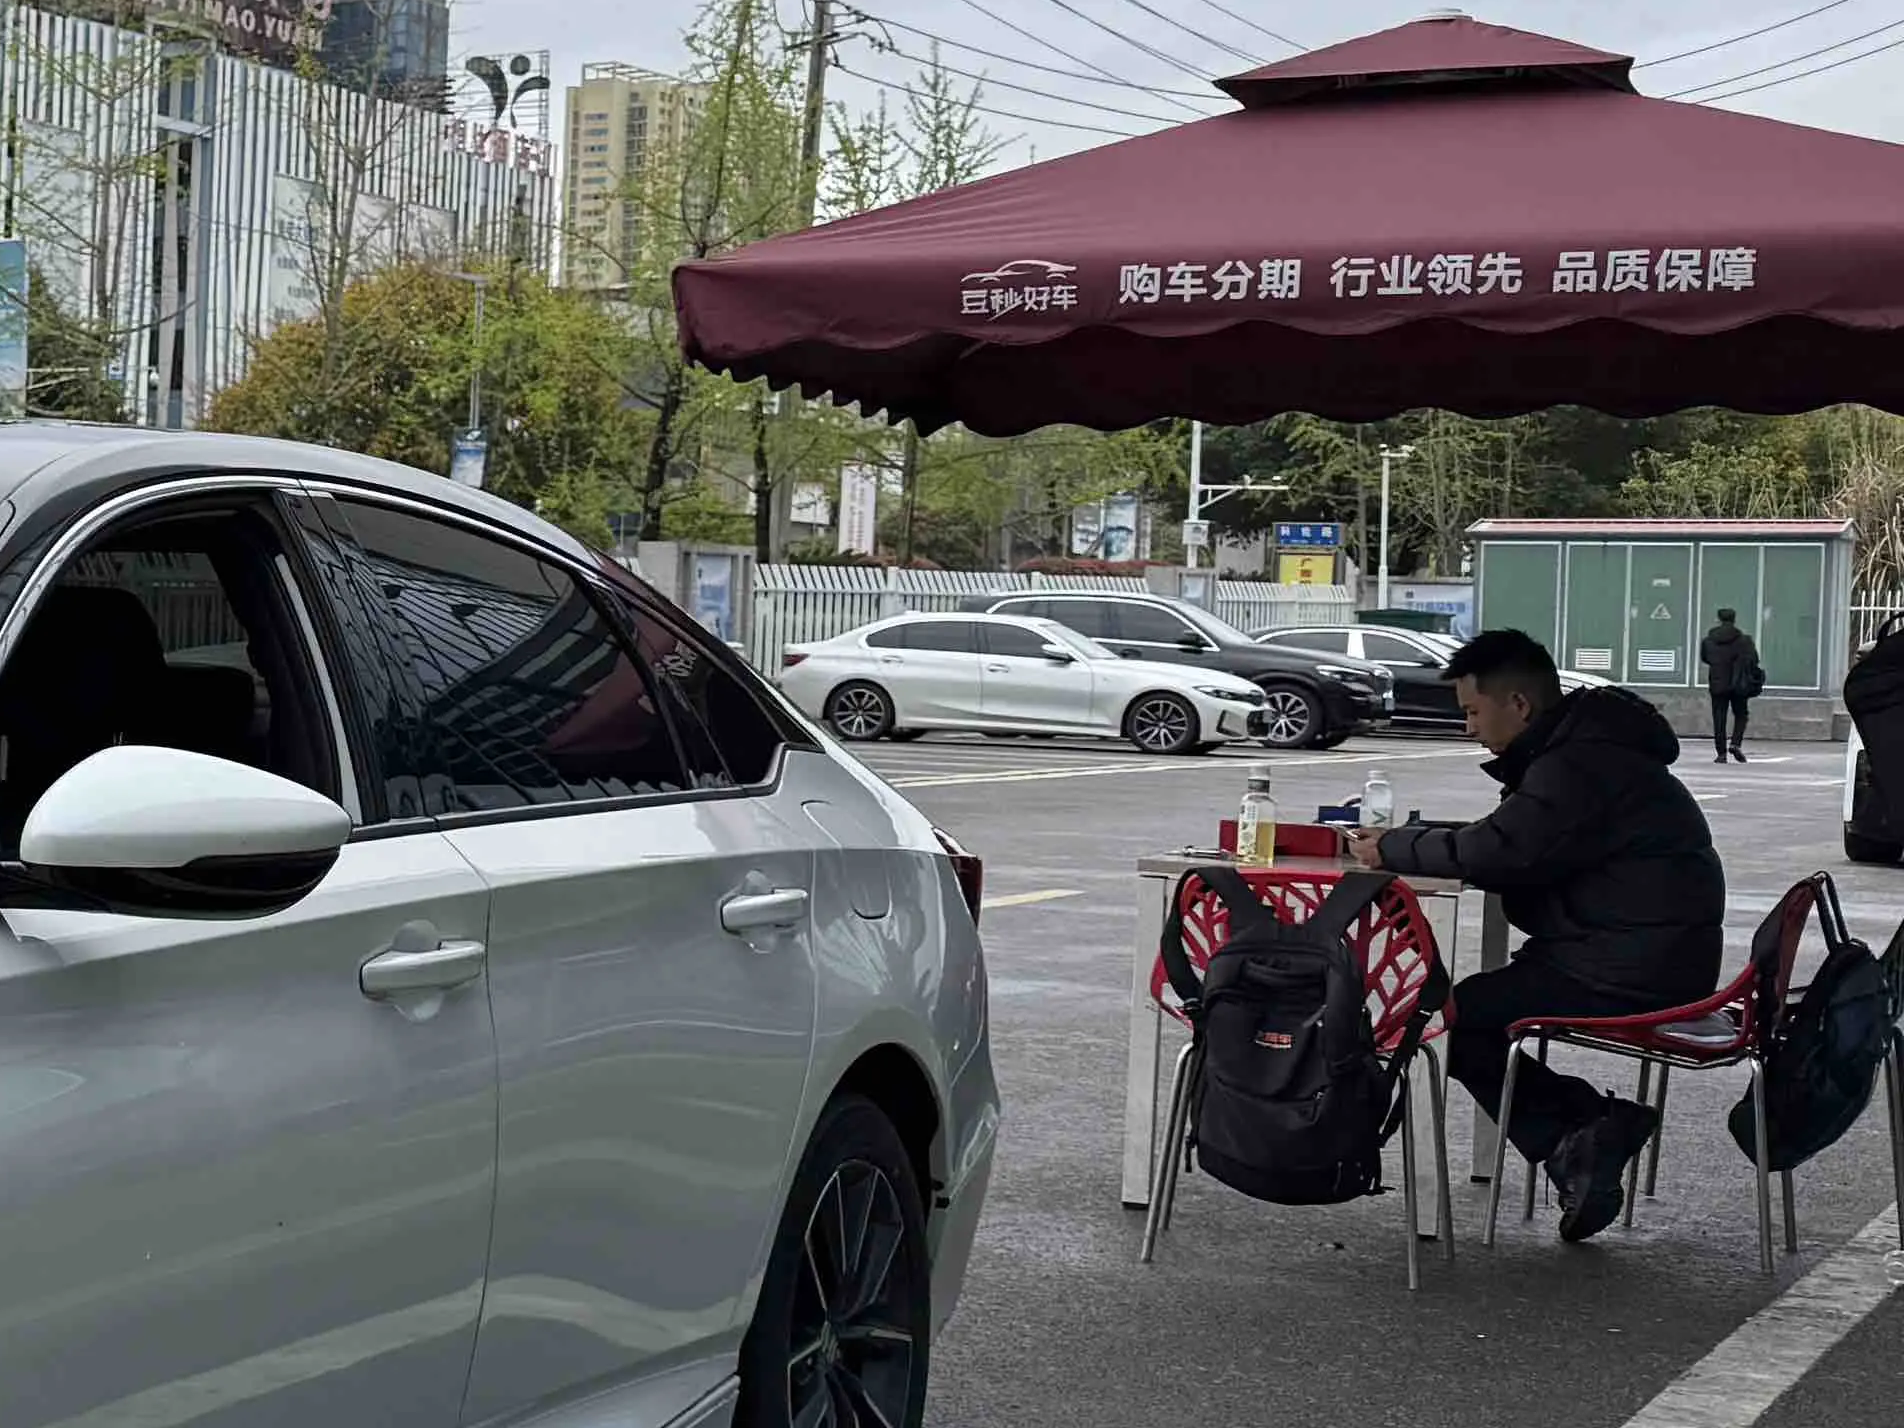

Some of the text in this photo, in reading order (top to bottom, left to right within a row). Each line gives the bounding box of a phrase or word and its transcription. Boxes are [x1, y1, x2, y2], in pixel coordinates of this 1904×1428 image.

[1118, 259, 1303, 305] 购车分期
[1329, 252, 1523, 299] 行业领先
[1551, 247, 1758, 294] 品质保障
